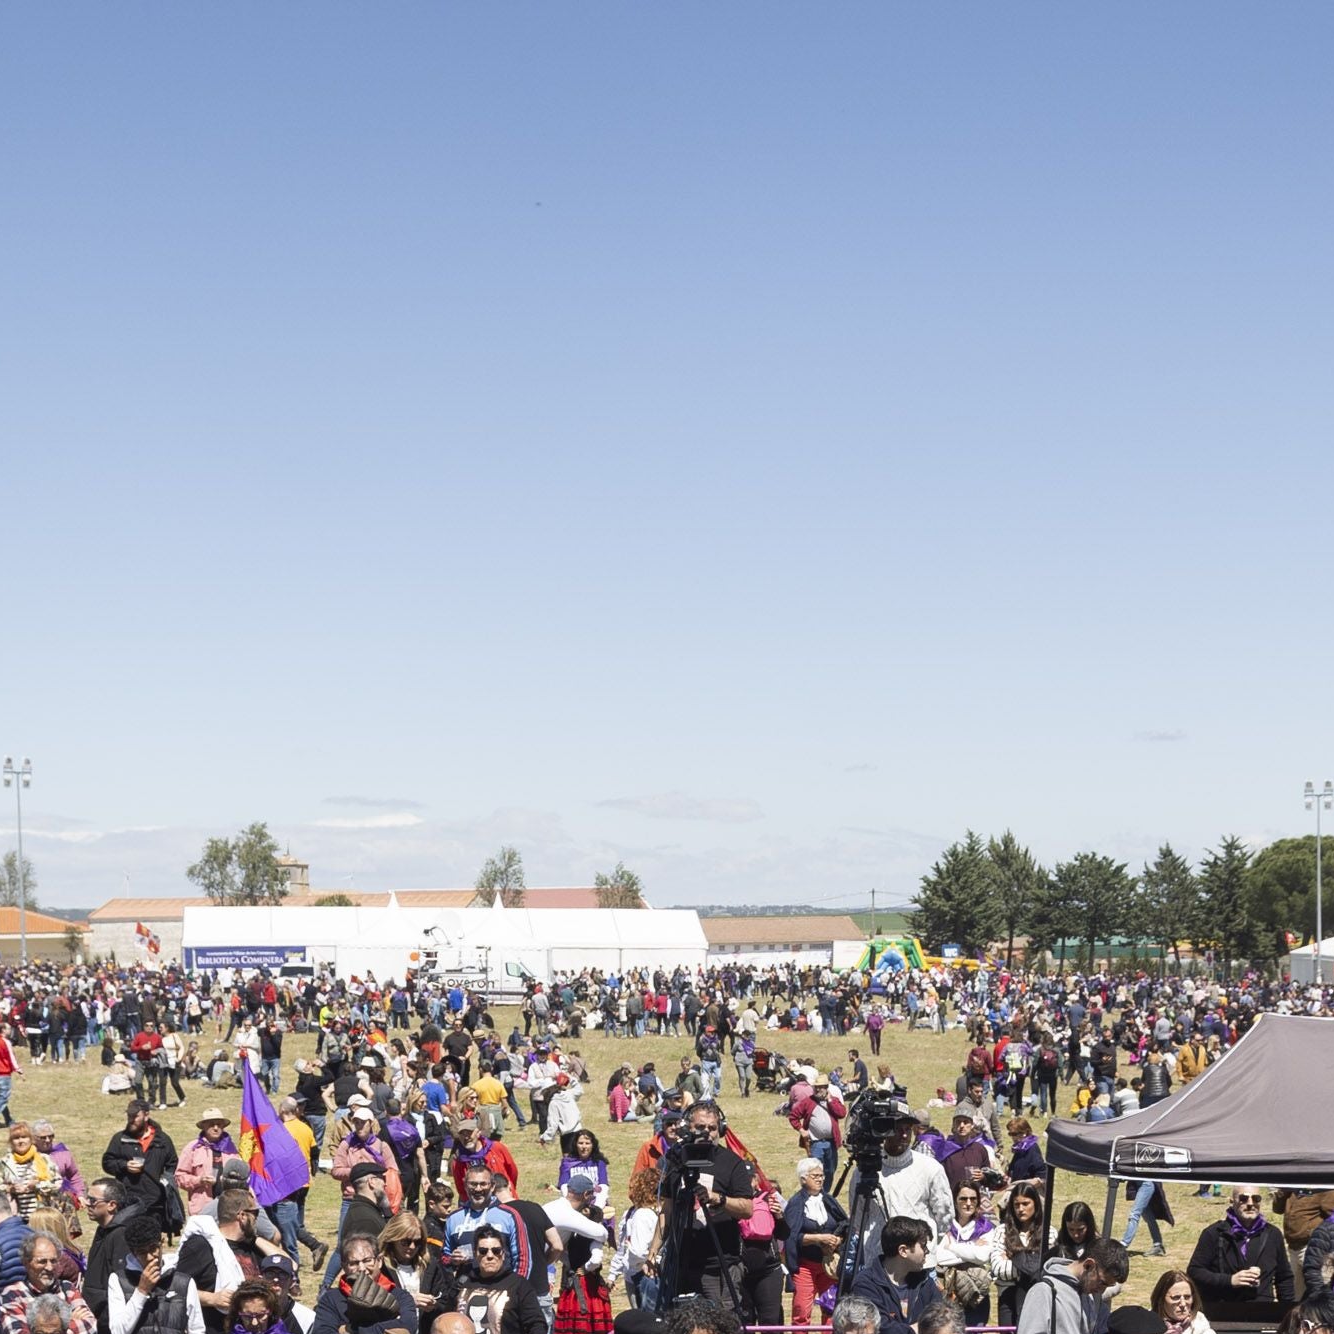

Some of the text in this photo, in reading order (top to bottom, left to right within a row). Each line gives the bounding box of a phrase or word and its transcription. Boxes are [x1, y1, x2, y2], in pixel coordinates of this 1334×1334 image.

[198, 955, 240, 965] BIBLIOTECA
[240, 955, 284, 964] COMUNERA
[447, 978, 495, 988] overon
